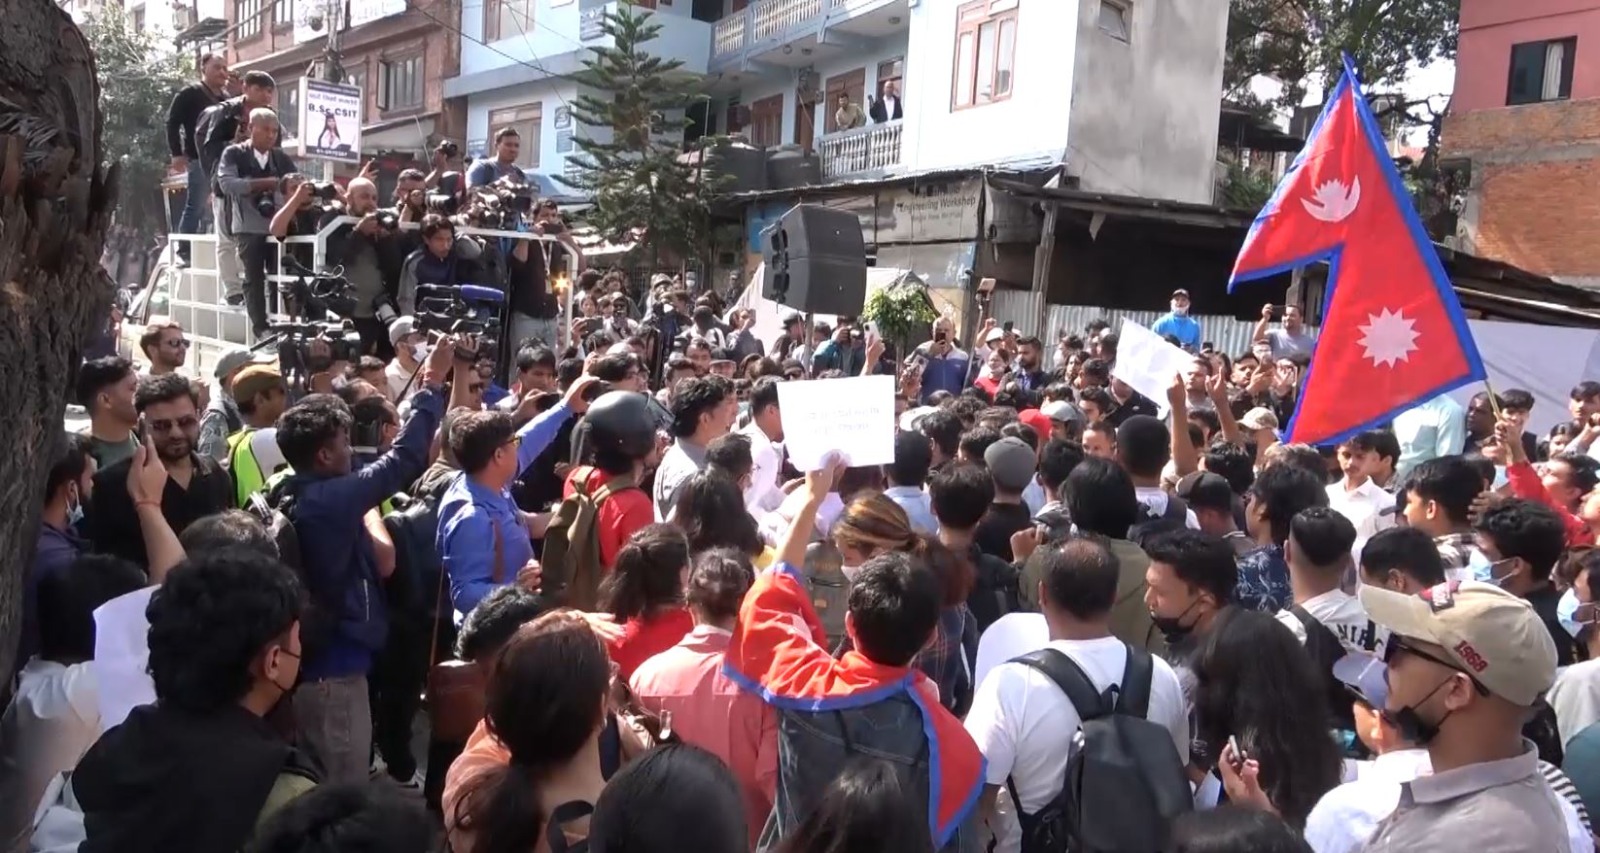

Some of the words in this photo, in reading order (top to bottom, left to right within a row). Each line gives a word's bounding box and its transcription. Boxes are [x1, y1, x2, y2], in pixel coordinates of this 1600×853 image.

[335, 107, 358, 119] CSIT
[940, 195, 976, 209] Workshop
[1453, 640, 1489, 673] 1968
